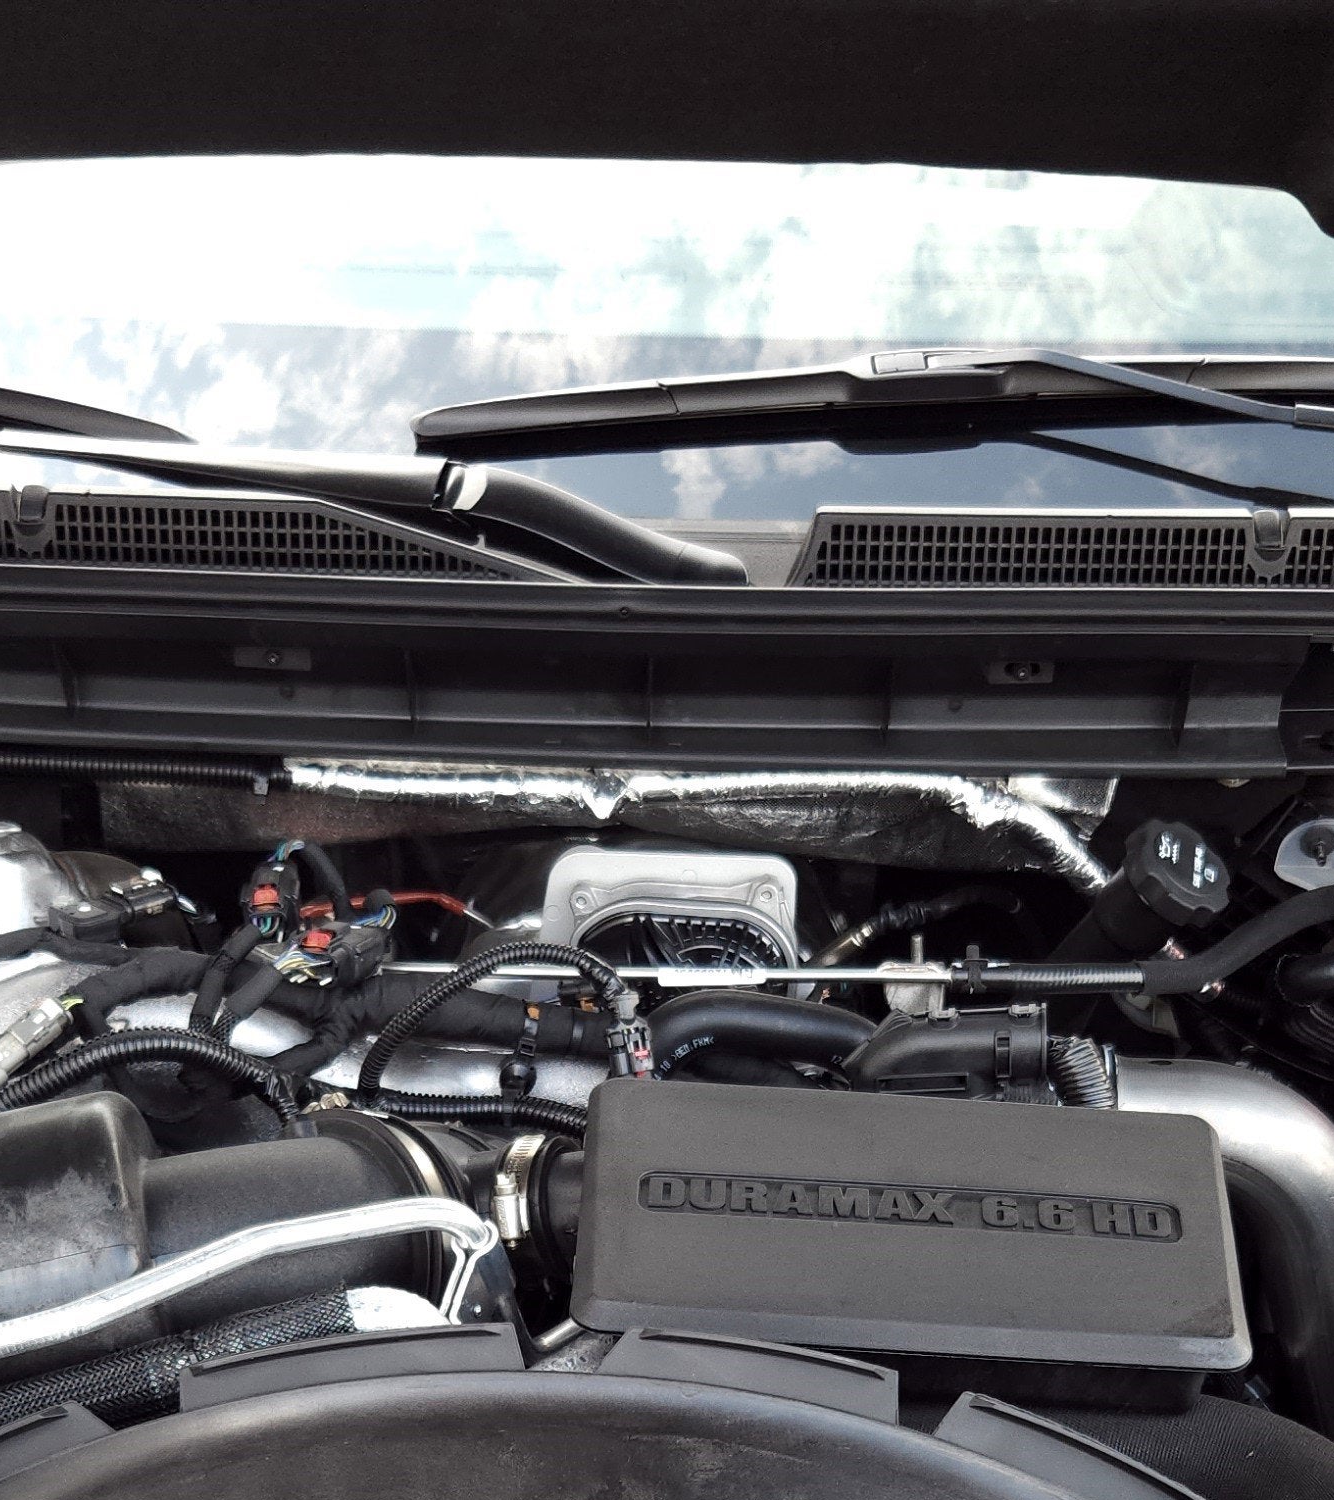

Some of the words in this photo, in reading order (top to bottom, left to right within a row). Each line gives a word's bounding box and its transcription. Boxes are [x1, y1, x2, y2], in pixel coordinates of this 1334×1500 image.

[646, 1176, 954, 1224] DURAMAX
[981, 1195, 1074, 1231] 6.6
[1090, 1203, 1171, 1238] HD
